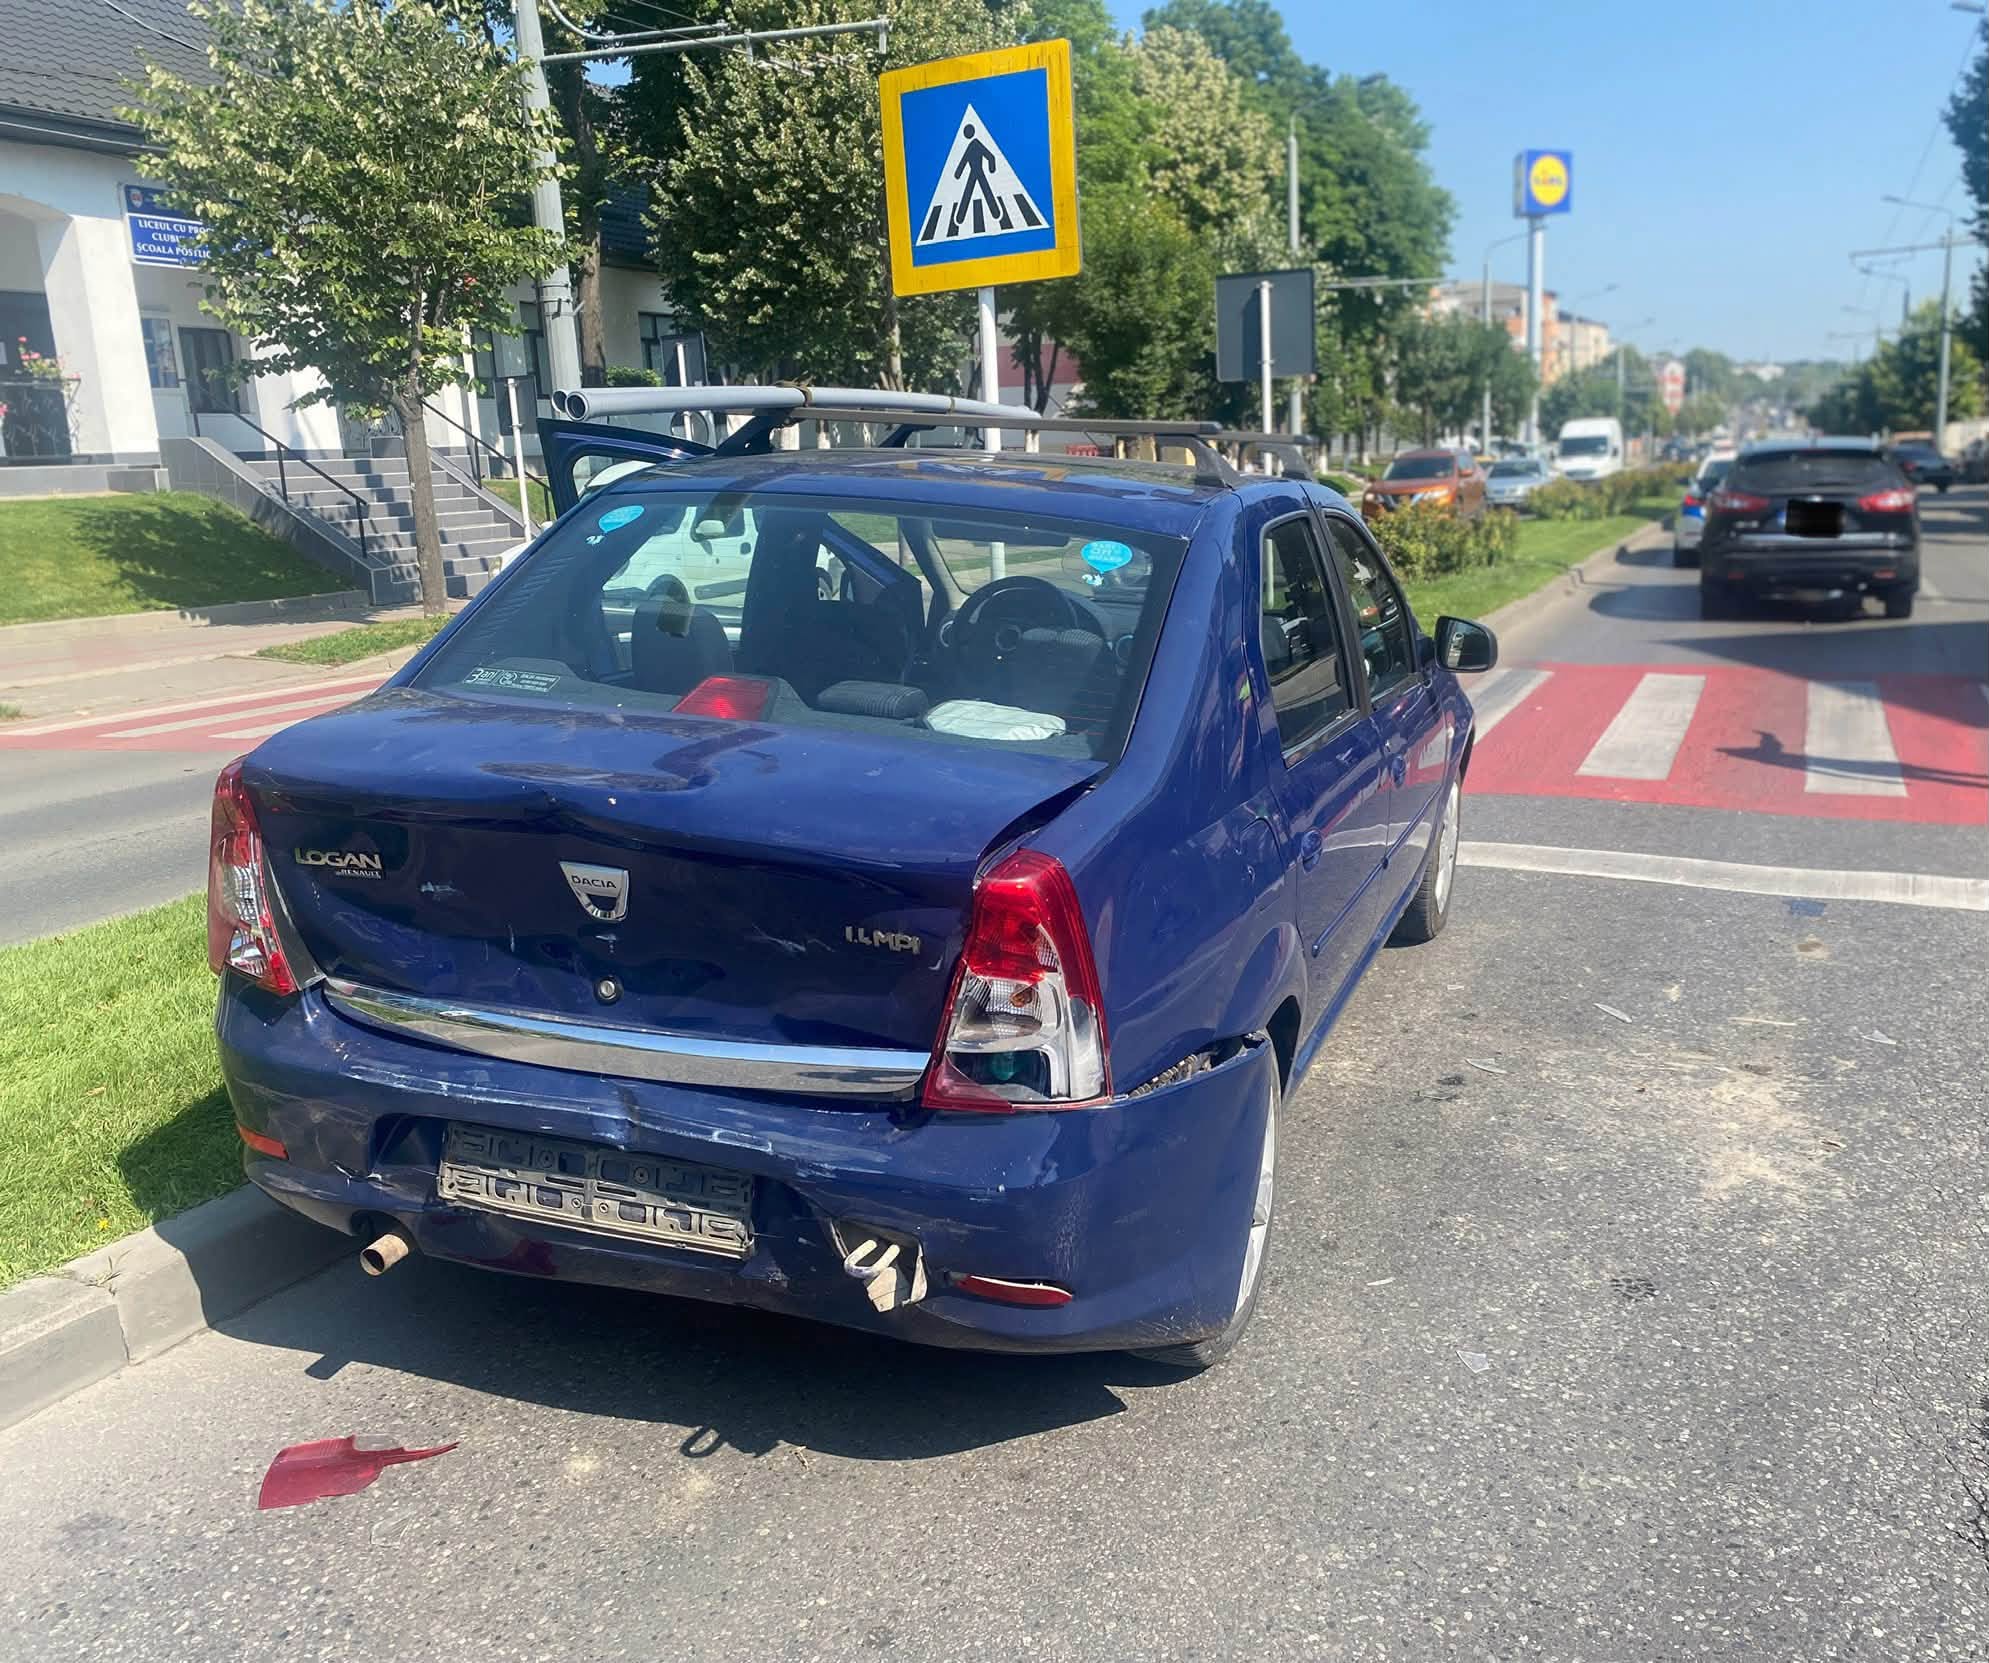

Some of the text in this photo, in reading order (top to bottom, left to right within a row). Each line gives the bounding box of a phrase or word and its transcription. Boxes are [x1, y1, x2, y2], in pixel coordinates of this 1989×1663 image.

[138, 219, 172, 231] LICEUL
[173, 223, 186, 233] CU
[294, 847, 382, 869] LOGAN
[571, 875, 617, 888] DACIA
